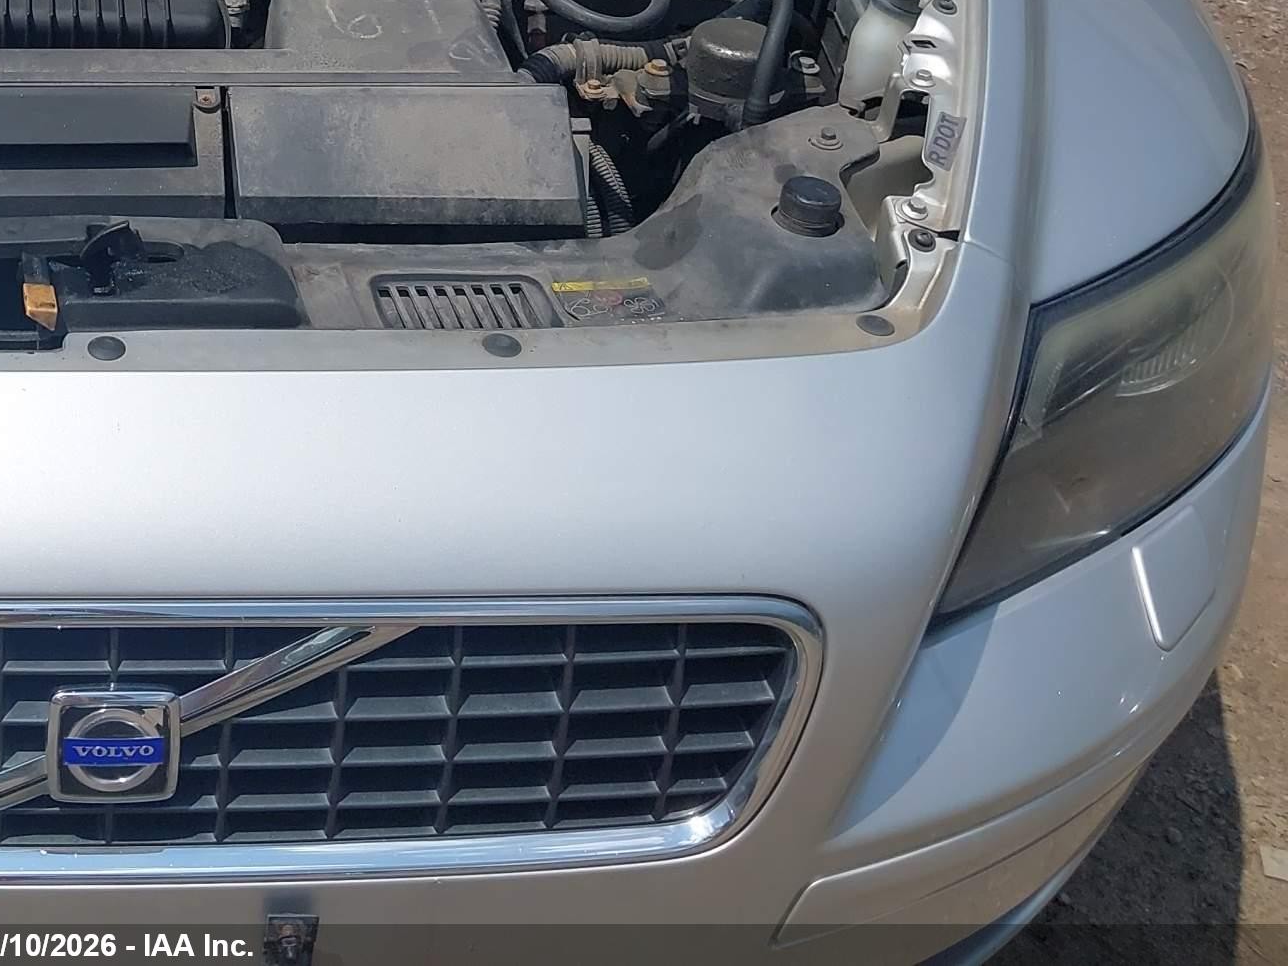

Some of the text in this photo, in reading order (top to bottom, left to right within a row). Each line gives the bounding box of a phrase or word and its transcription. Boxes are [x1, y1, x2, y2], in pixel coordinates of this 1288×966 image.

[928, 111, 959, 167] R DOT
[72, 745, 155, 758] VOLVO
